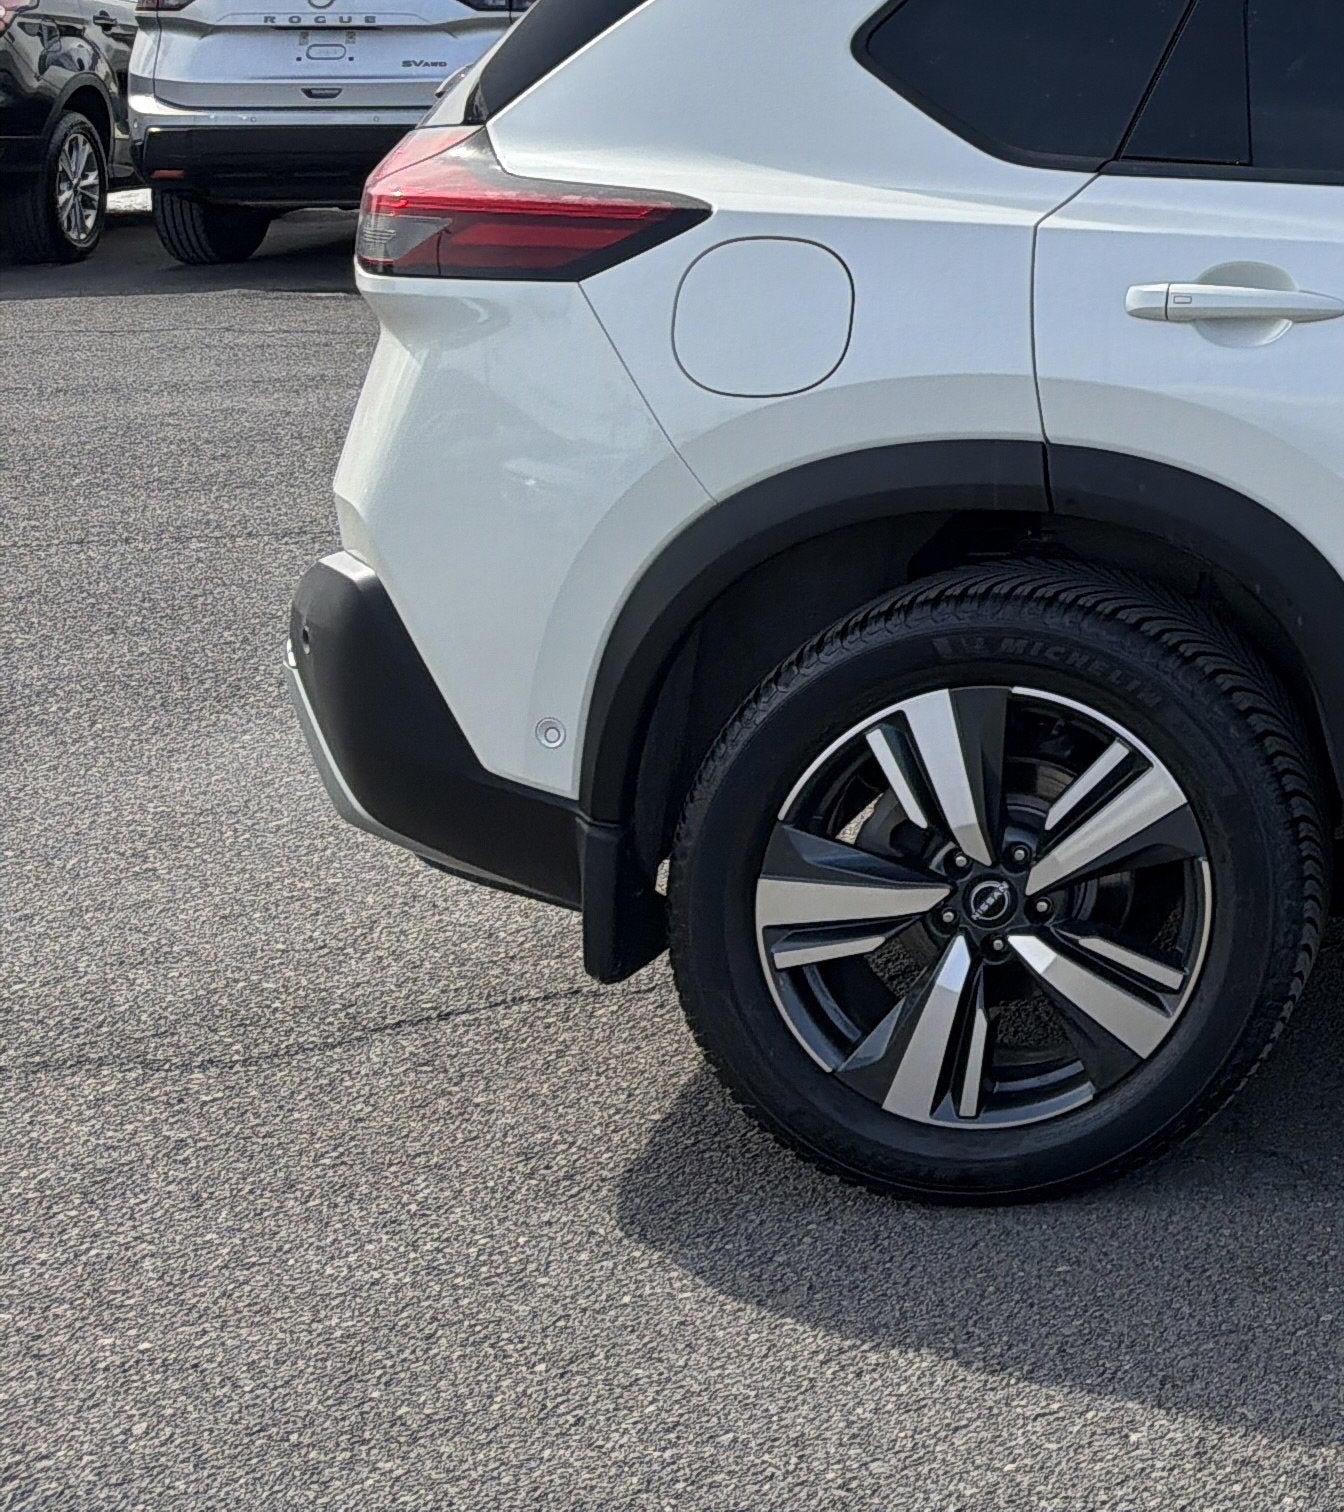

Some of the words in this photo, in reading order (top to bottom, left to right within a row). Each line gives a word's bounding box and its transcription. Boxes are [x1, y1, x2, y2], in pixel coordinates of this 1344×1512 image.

[263, 15, 376, 24] ROGUE
[1000, 636, 1164, 709] MICHELIN
[970, 880, 1009, 921] NISSAN
